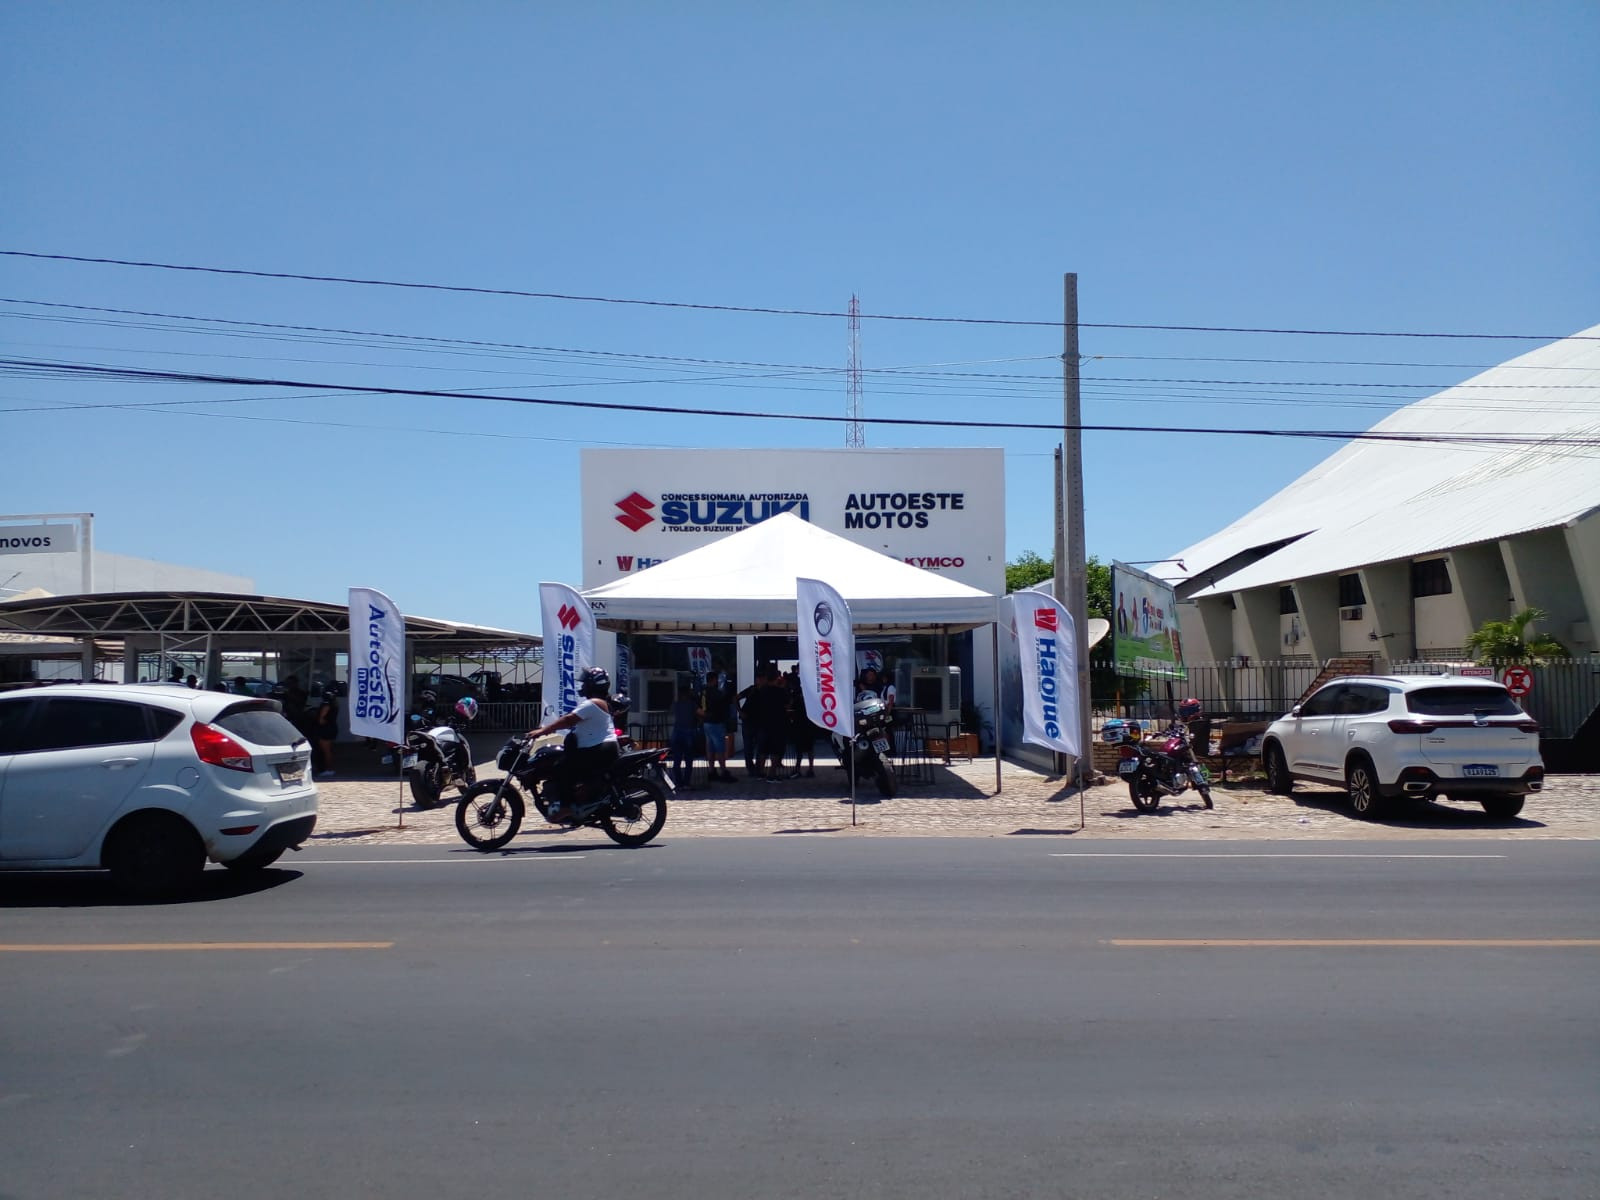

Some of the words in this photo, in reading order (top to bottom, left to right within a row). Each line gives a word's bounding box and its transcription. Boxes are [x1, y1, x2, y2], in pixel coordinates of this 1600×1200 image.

[661, 493, 746, 501] CONCESSIONARIA
[845, 493, 964, 511] AUTOESTE
[845, 511, 929, 529] MOTOS
[0, 537, 51, 548] novos
[904, 557, 964, 568] KYMCO
[368, 604, 387, 719] Autoeste
[356, 669, 367, 716] motos
[818, 640, 838, 728] KYMCO
